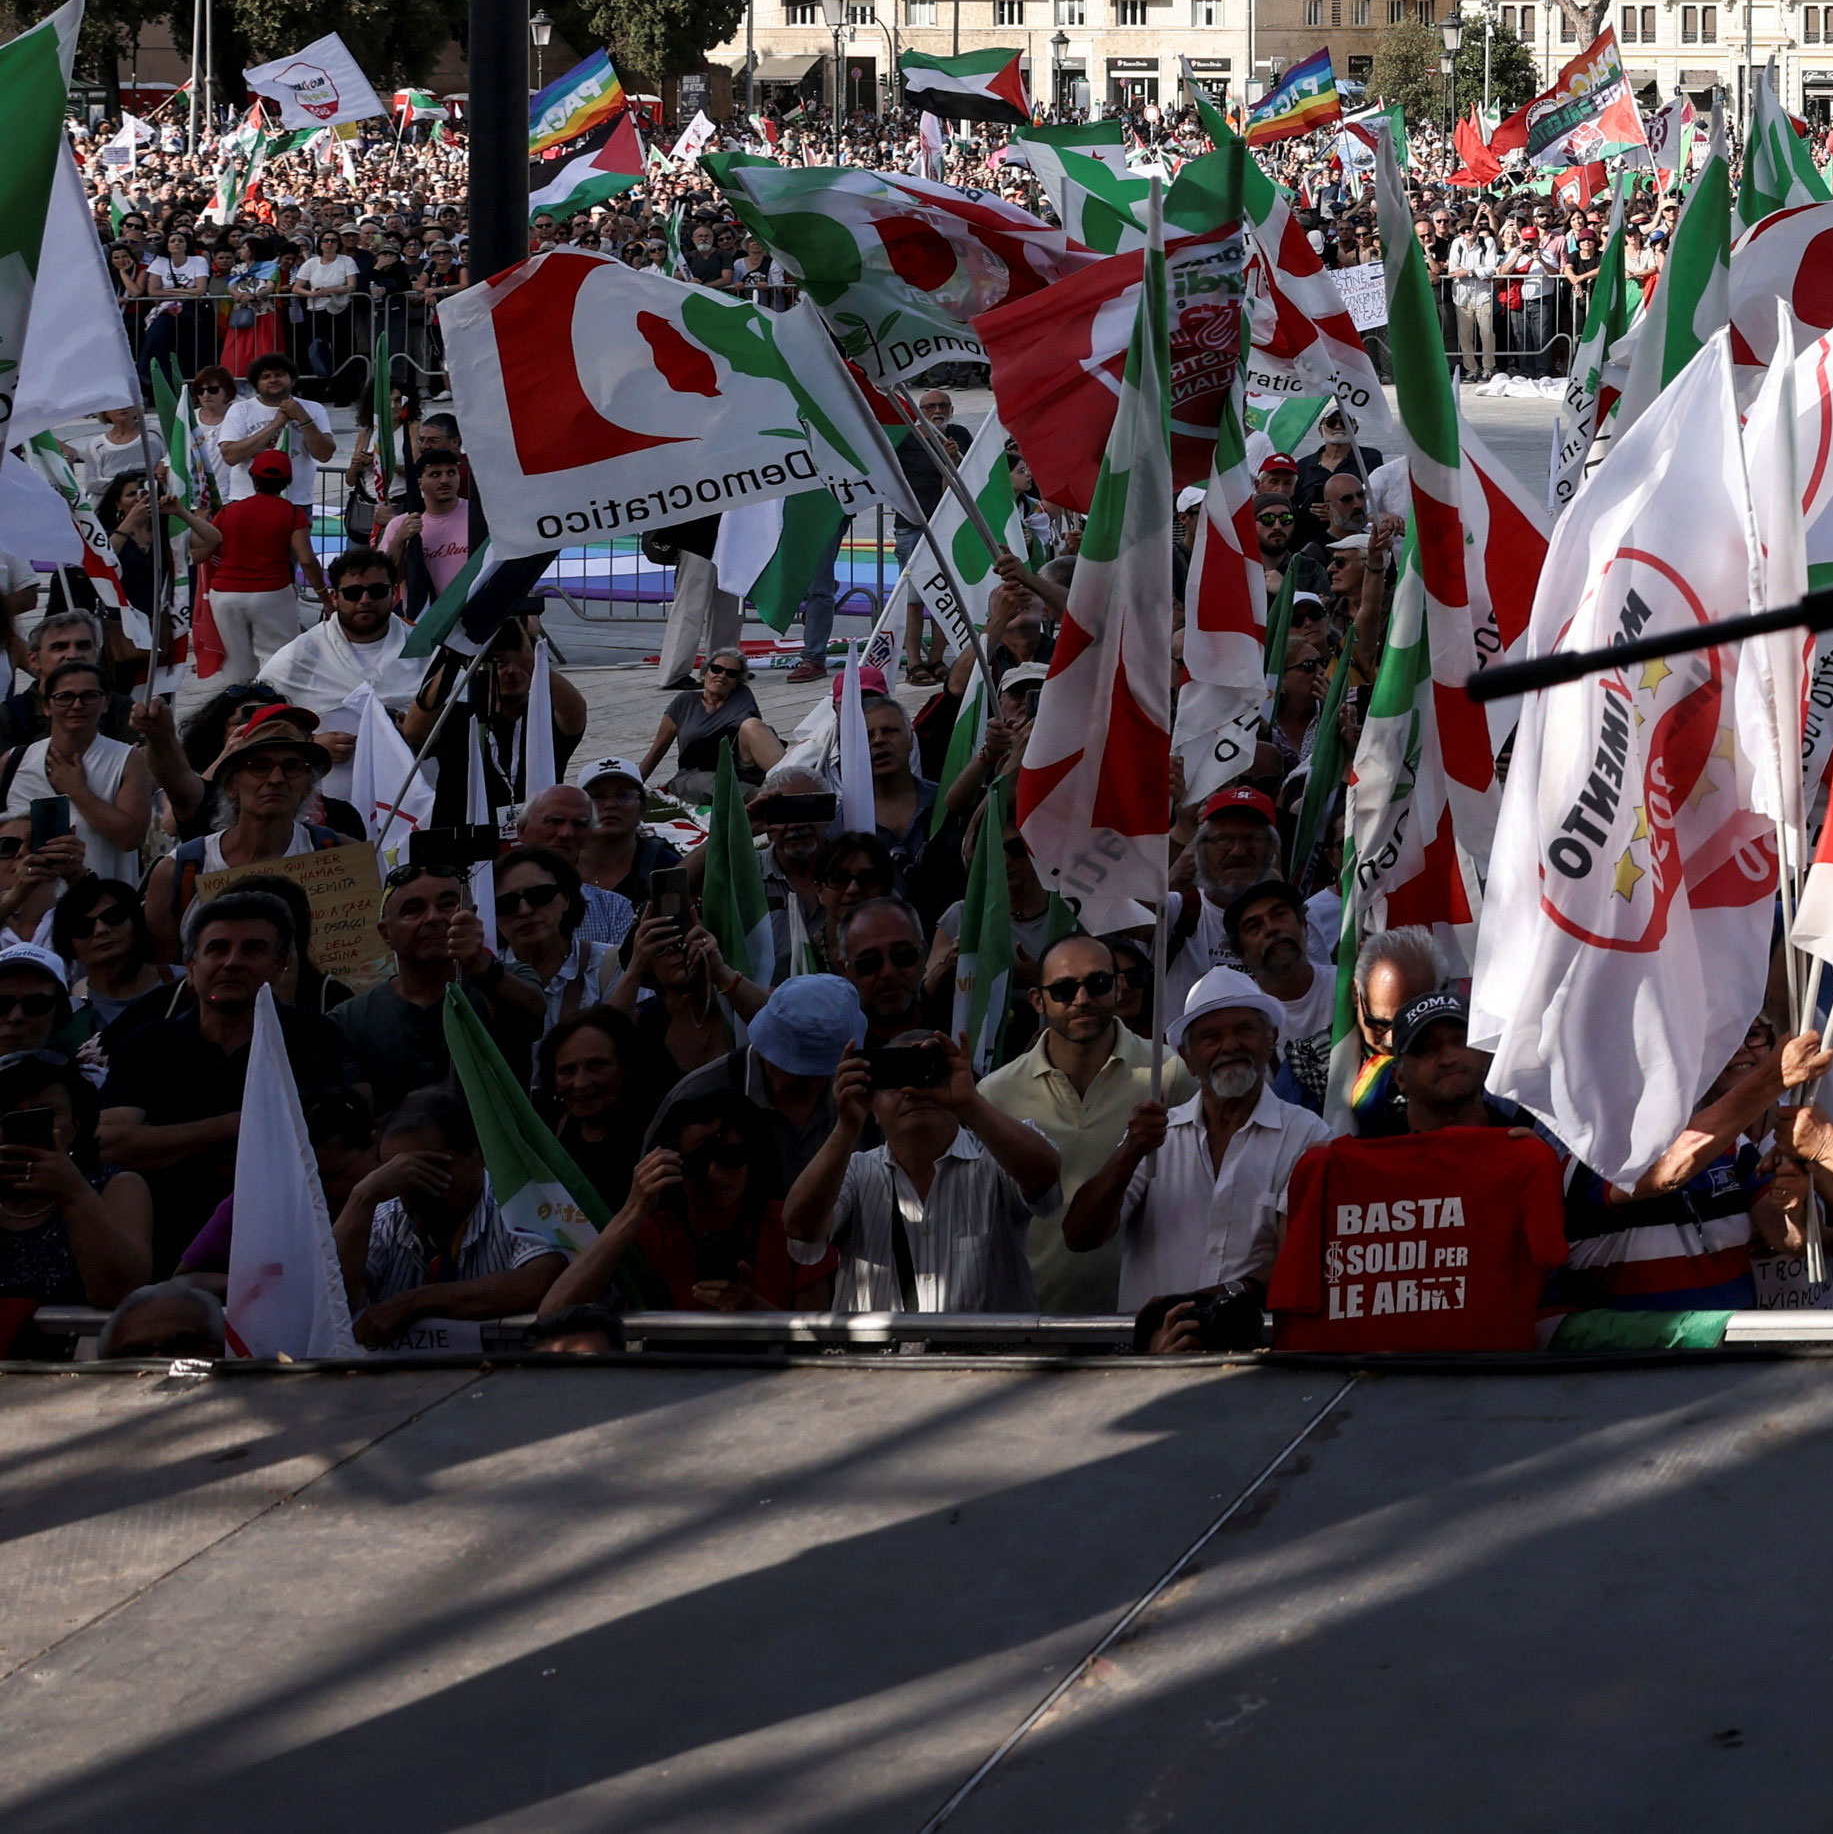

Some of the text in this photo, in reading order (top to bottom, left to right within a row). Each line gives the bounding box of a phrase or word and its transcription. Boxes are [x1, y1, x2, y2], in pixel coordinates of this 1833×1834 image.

[1404, 995, 1462, 1023] ROMA
[1336, 1196, 1466, 1236] BASTA
[1433, 1245, 1469, 1269] PER
[1328, 1281, 1364, 1320] LE
